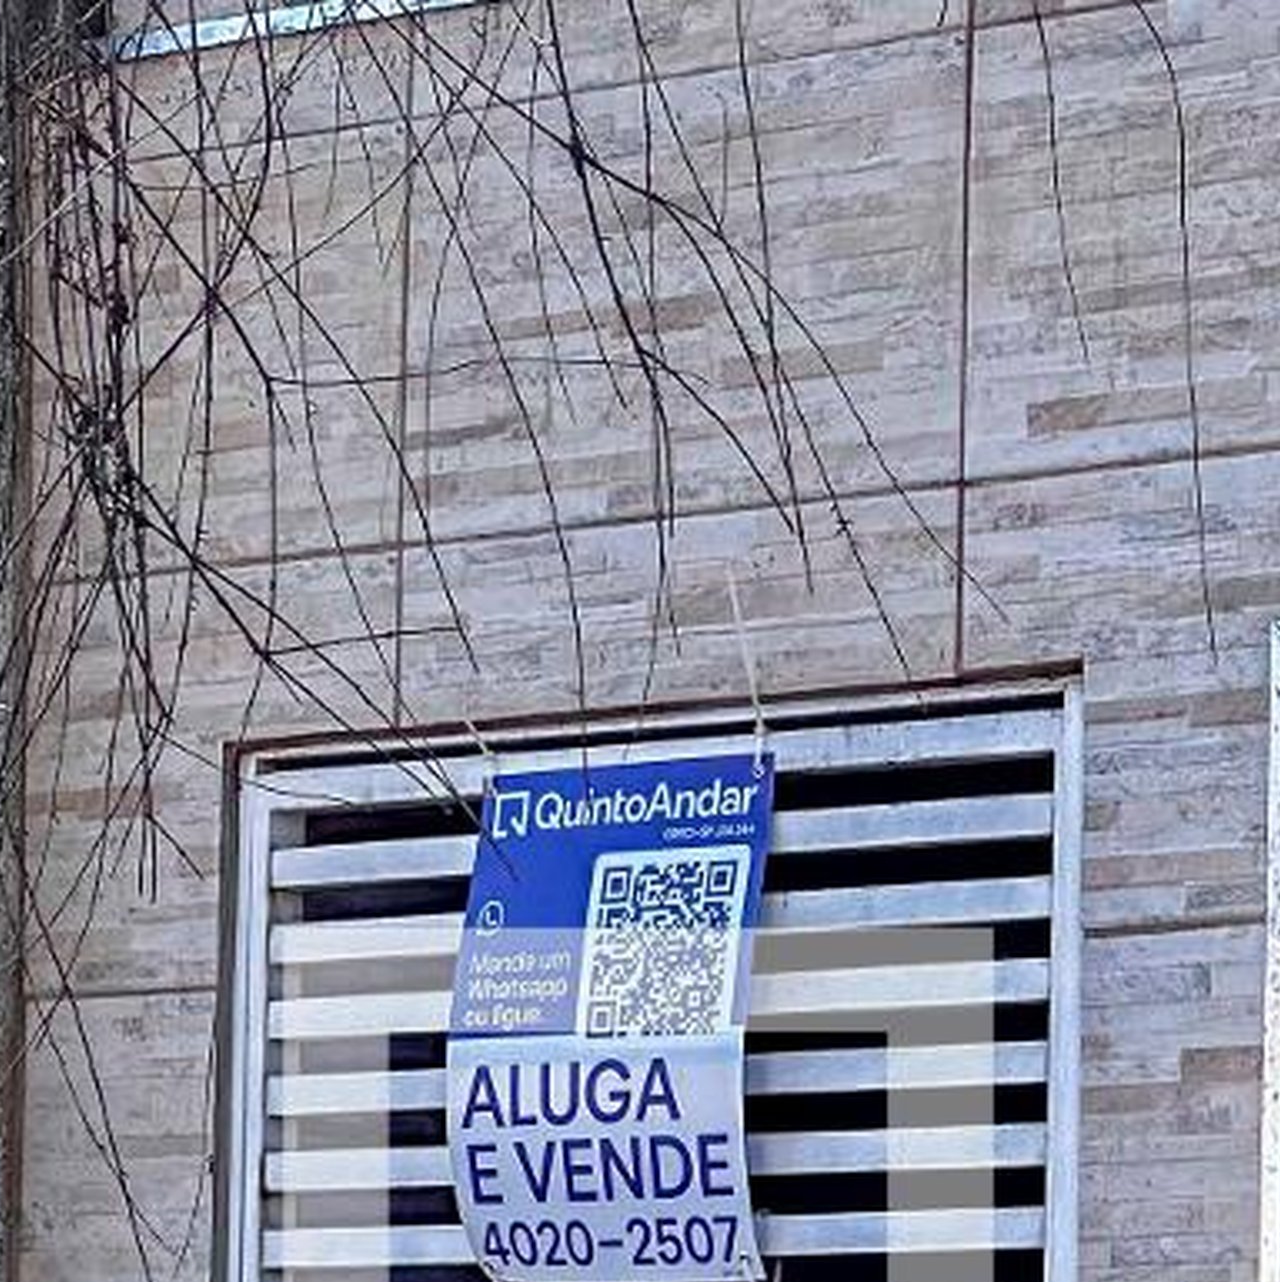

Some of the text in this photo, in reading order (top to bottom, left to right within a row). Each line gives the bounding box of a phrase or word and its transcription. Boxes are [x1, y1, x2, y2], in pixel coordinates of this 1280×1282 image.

[535, 778, 759, 830] QuintoAndar
[461, 1057, 681, 1129] ALUGA
[467, 1133, 734, 1205] E VENDE
[483, 1215, 738, 1267] 4020-2507
